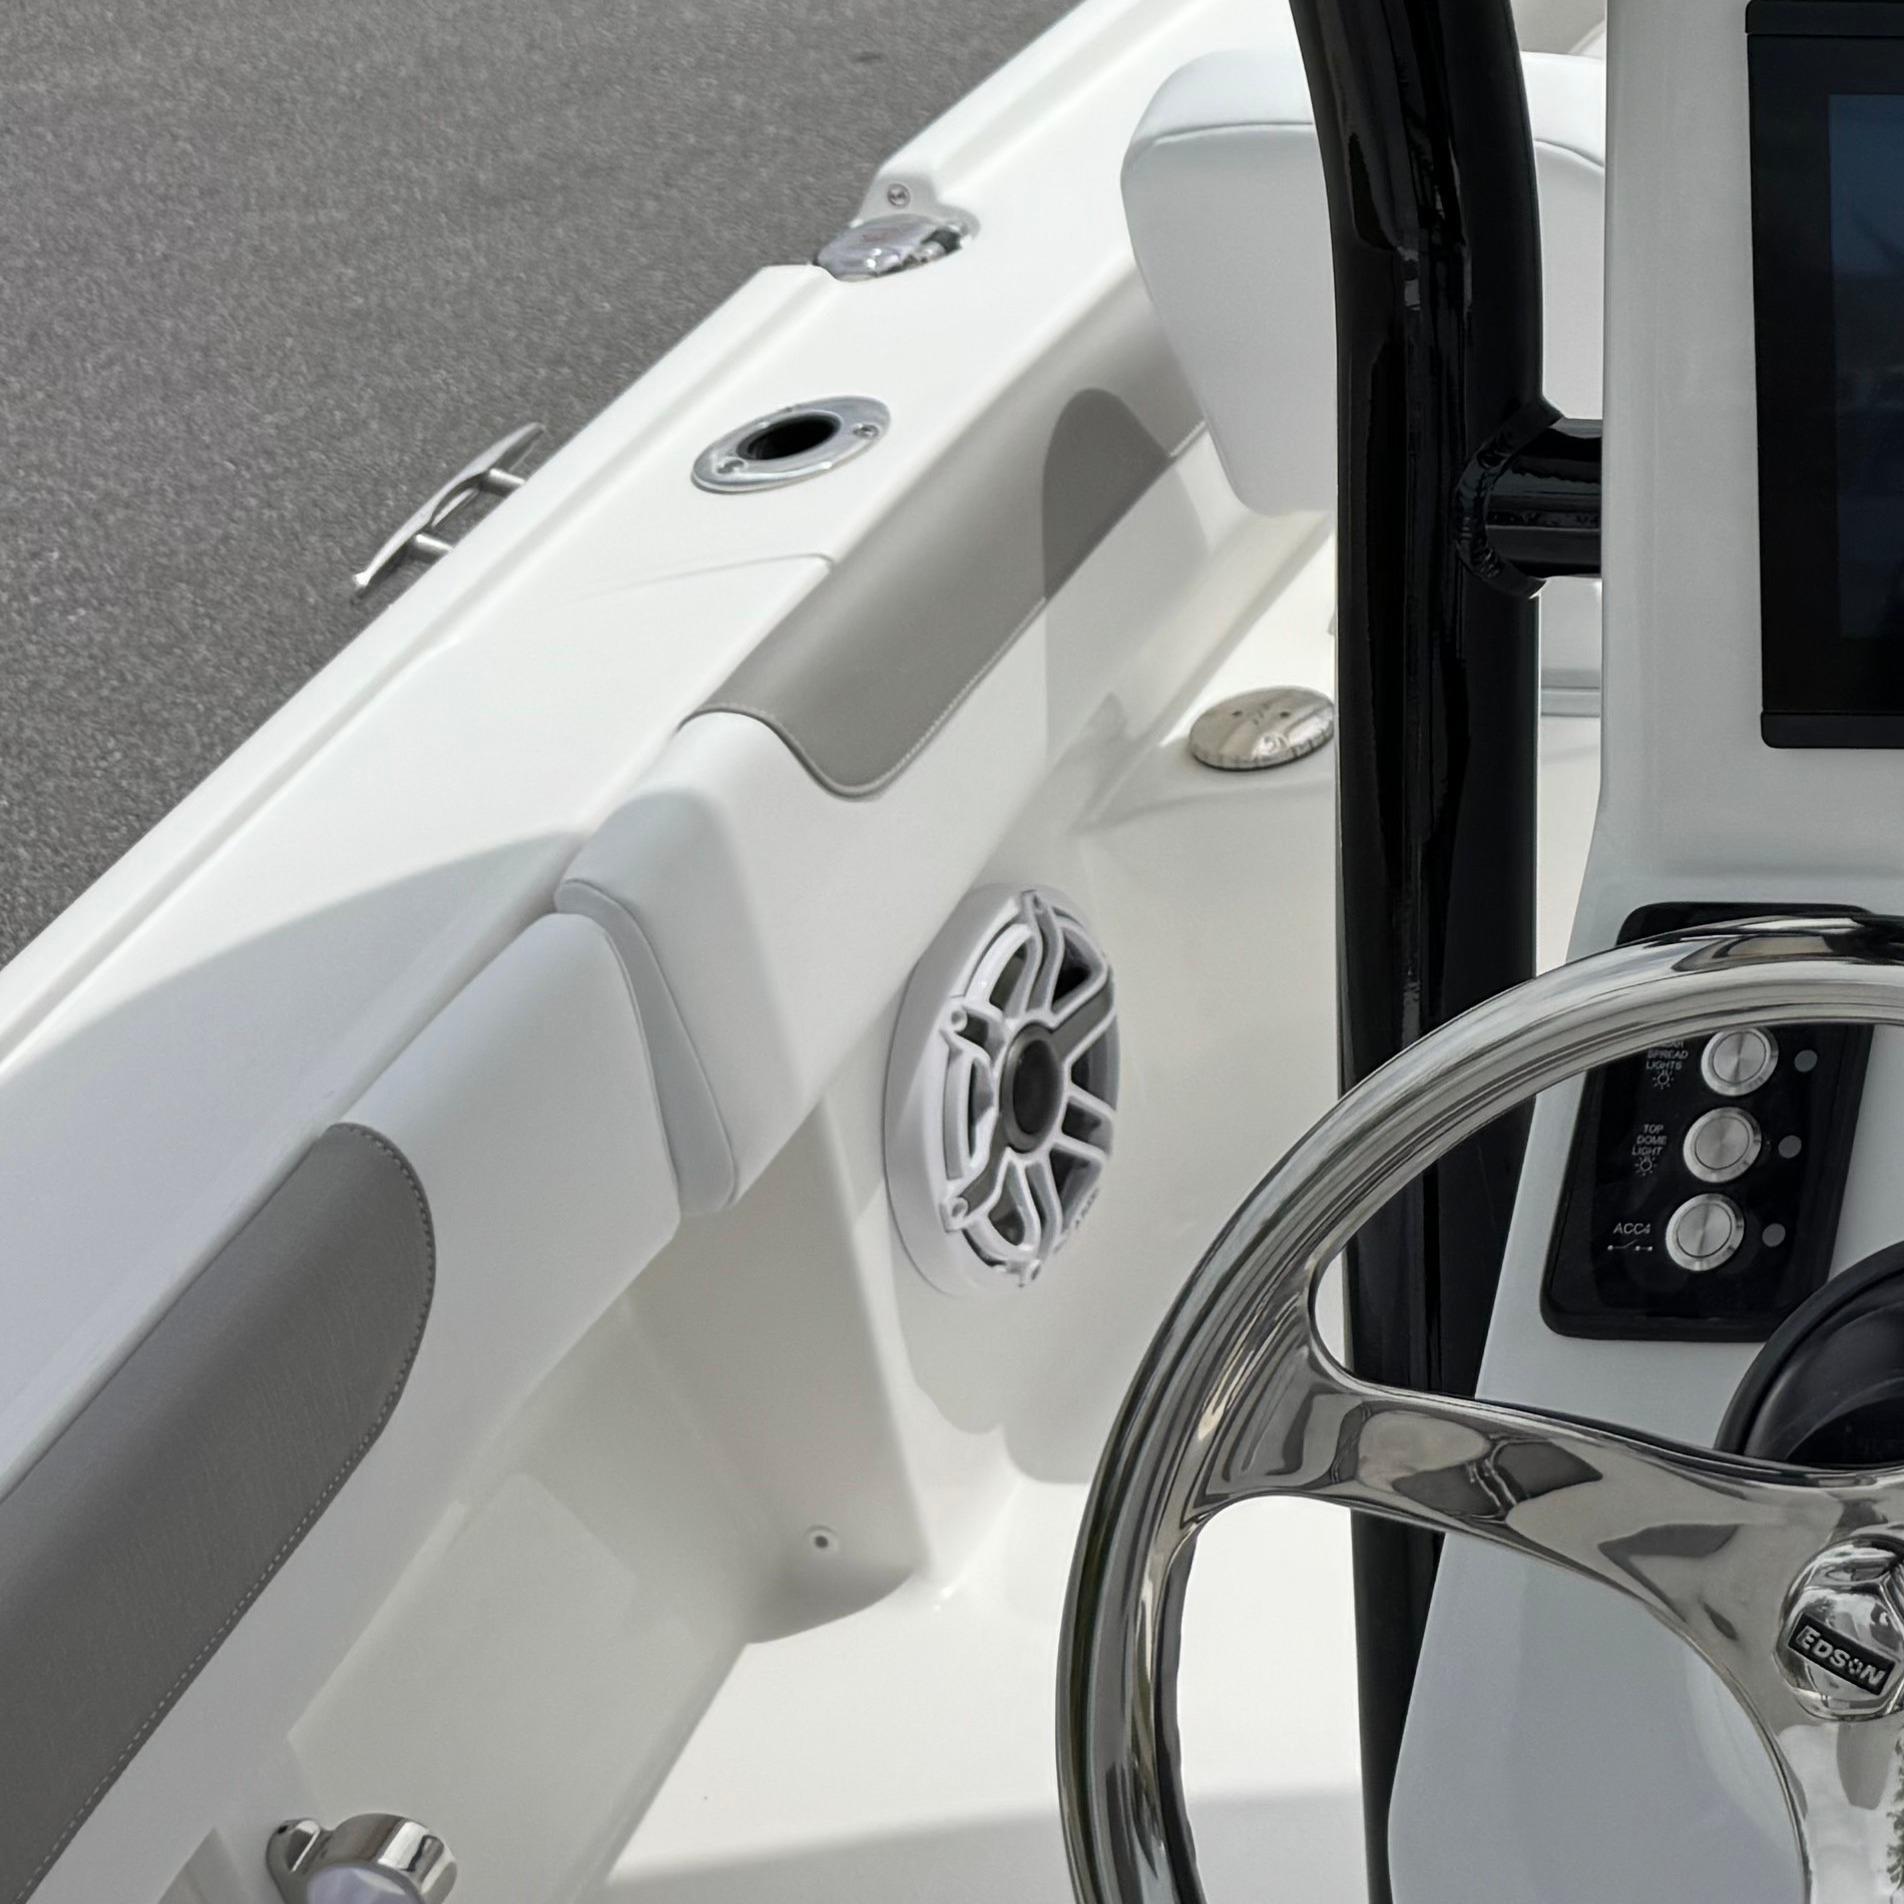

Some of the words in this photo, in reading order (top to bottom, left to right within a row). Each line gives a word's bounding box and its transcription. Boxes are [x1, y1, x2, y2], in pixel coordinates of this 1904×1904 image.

[1643, 1124, 1664, 1134] TOP
[1636, 1135, 1667, 1145] DOME
[1631, 1146, 1663, 1156] LIGHT
[1796, 1624, 1886, 1685] EDSON
